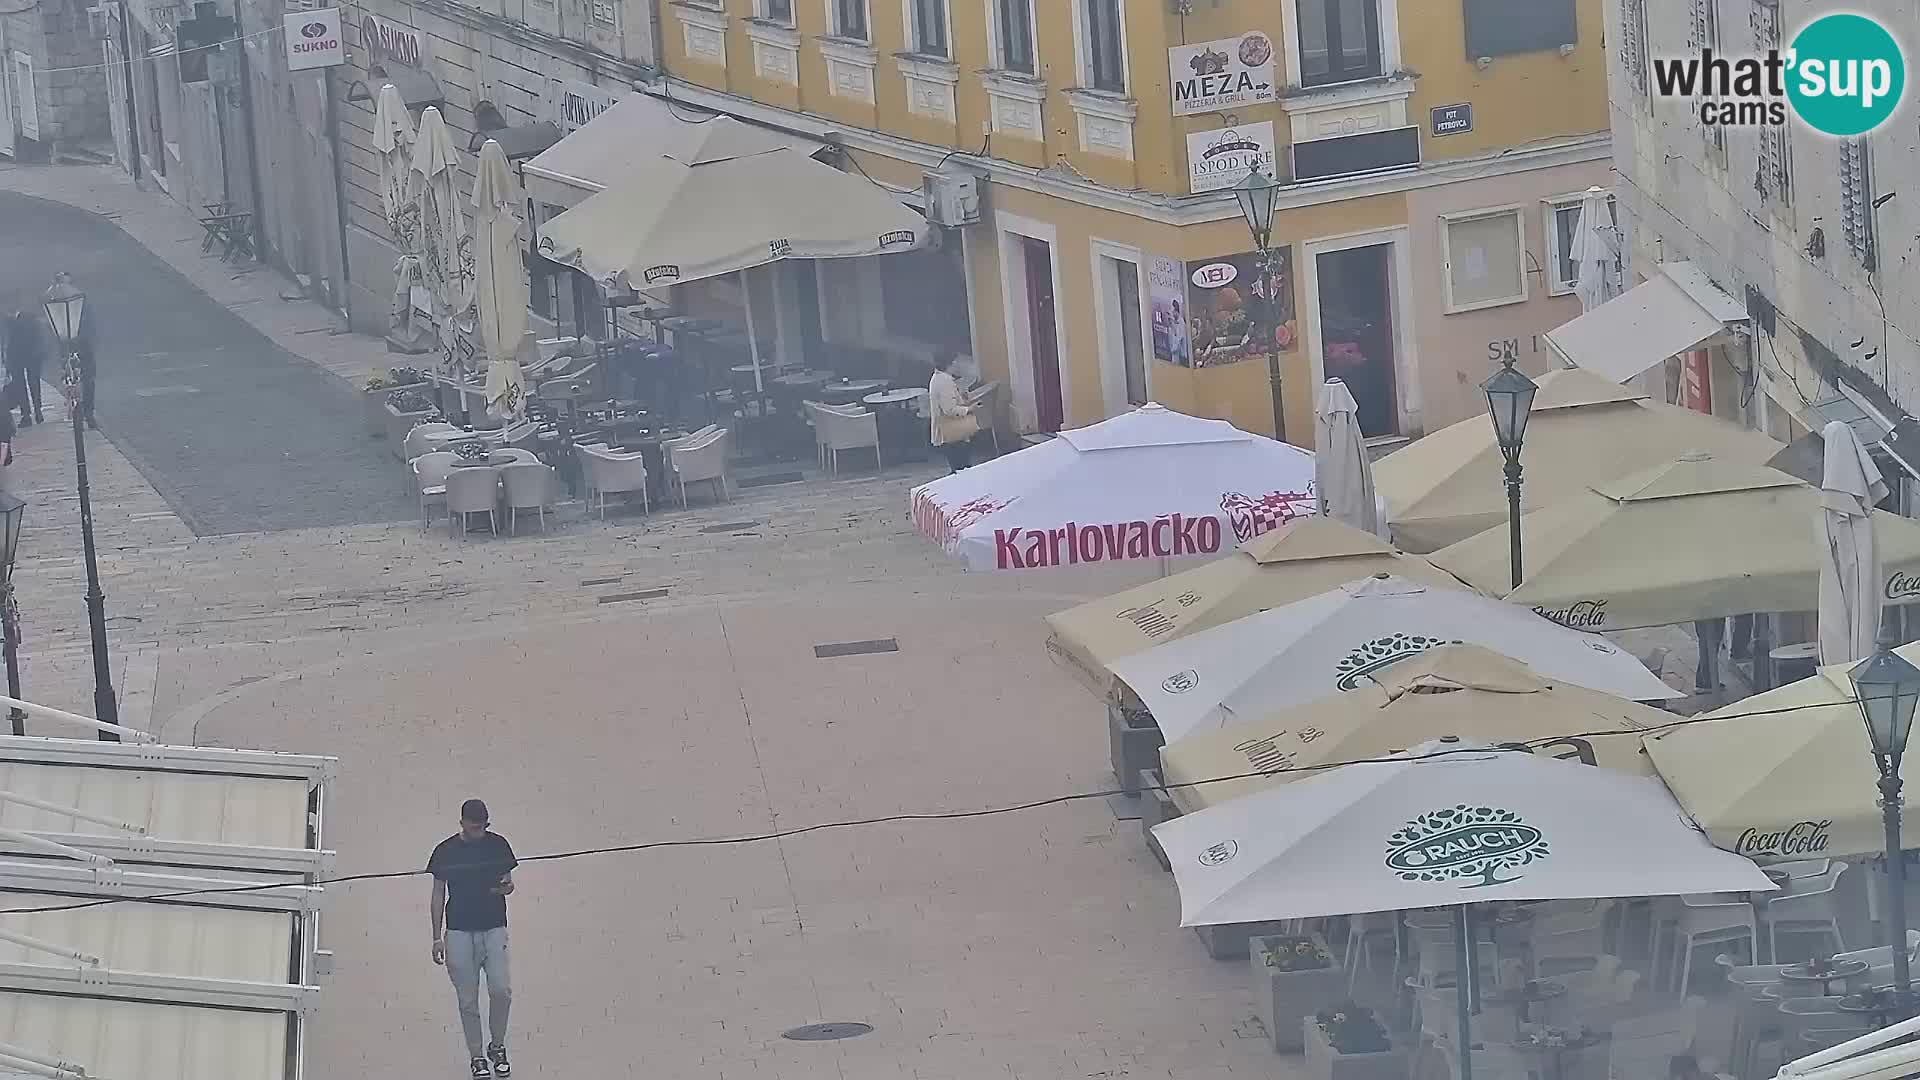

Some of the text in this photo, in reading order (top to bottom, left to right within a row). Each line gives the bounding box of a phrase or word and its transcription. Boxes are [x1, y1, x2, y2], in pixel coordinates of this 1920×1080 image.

[293, 39, 338, 53] SUKNO
[380, 24, 419, 64] SUKNO
[1175, 71, 1254, 101] MEZA
[1184, 97, 1217, 109] PIZZERIA
[1225, 94, 1246, 104] GRILL
[1437, 120, 1467, 131] PETROVCA
[1446, 111, 1457, 119] PUT
[1193, 157, 1239, 174] ISPOD
[1244, 151, 1272, 167] URE
[994, 513, 1221, 569] Karlovačko
[1425, 829, 1525, 861] RAUCH
